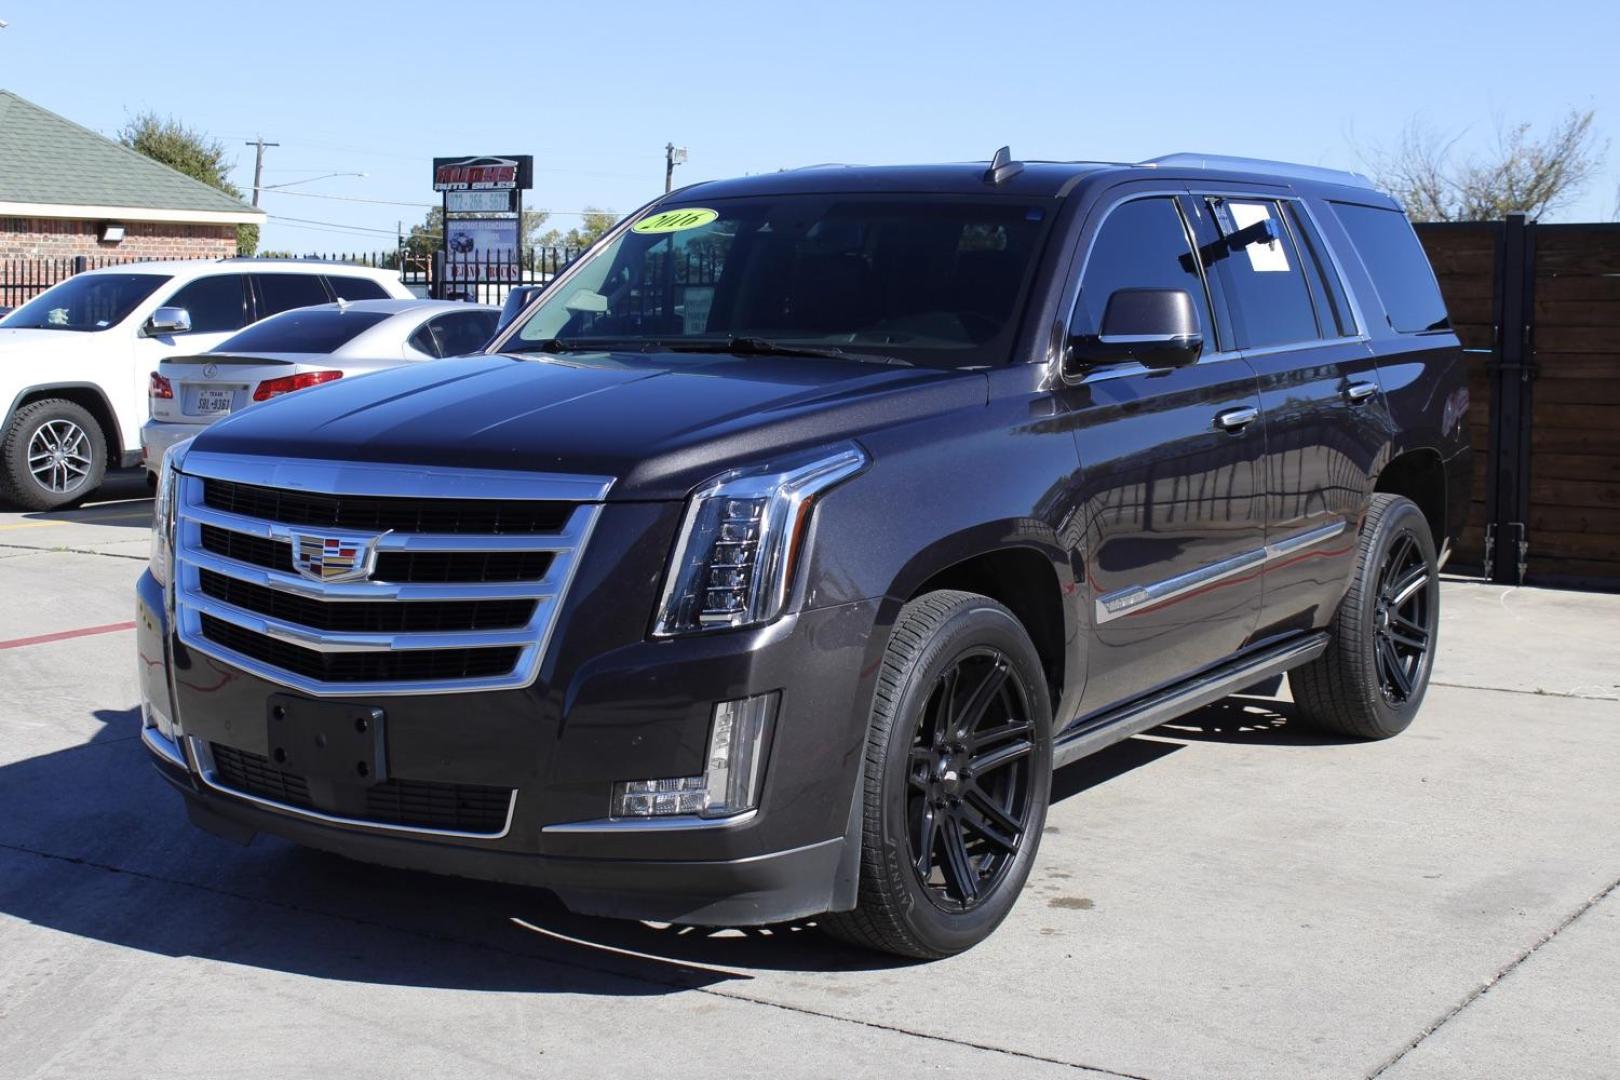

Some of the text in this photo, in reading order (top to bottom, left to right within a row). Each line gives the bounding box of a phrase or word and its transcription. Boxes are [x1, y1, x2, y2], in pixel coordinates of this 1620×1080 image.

[435, 181, 516, 190] AUTO SALES
[640, 212, 708, 230] 2016
[484, 266, 517, 278] TRCS
